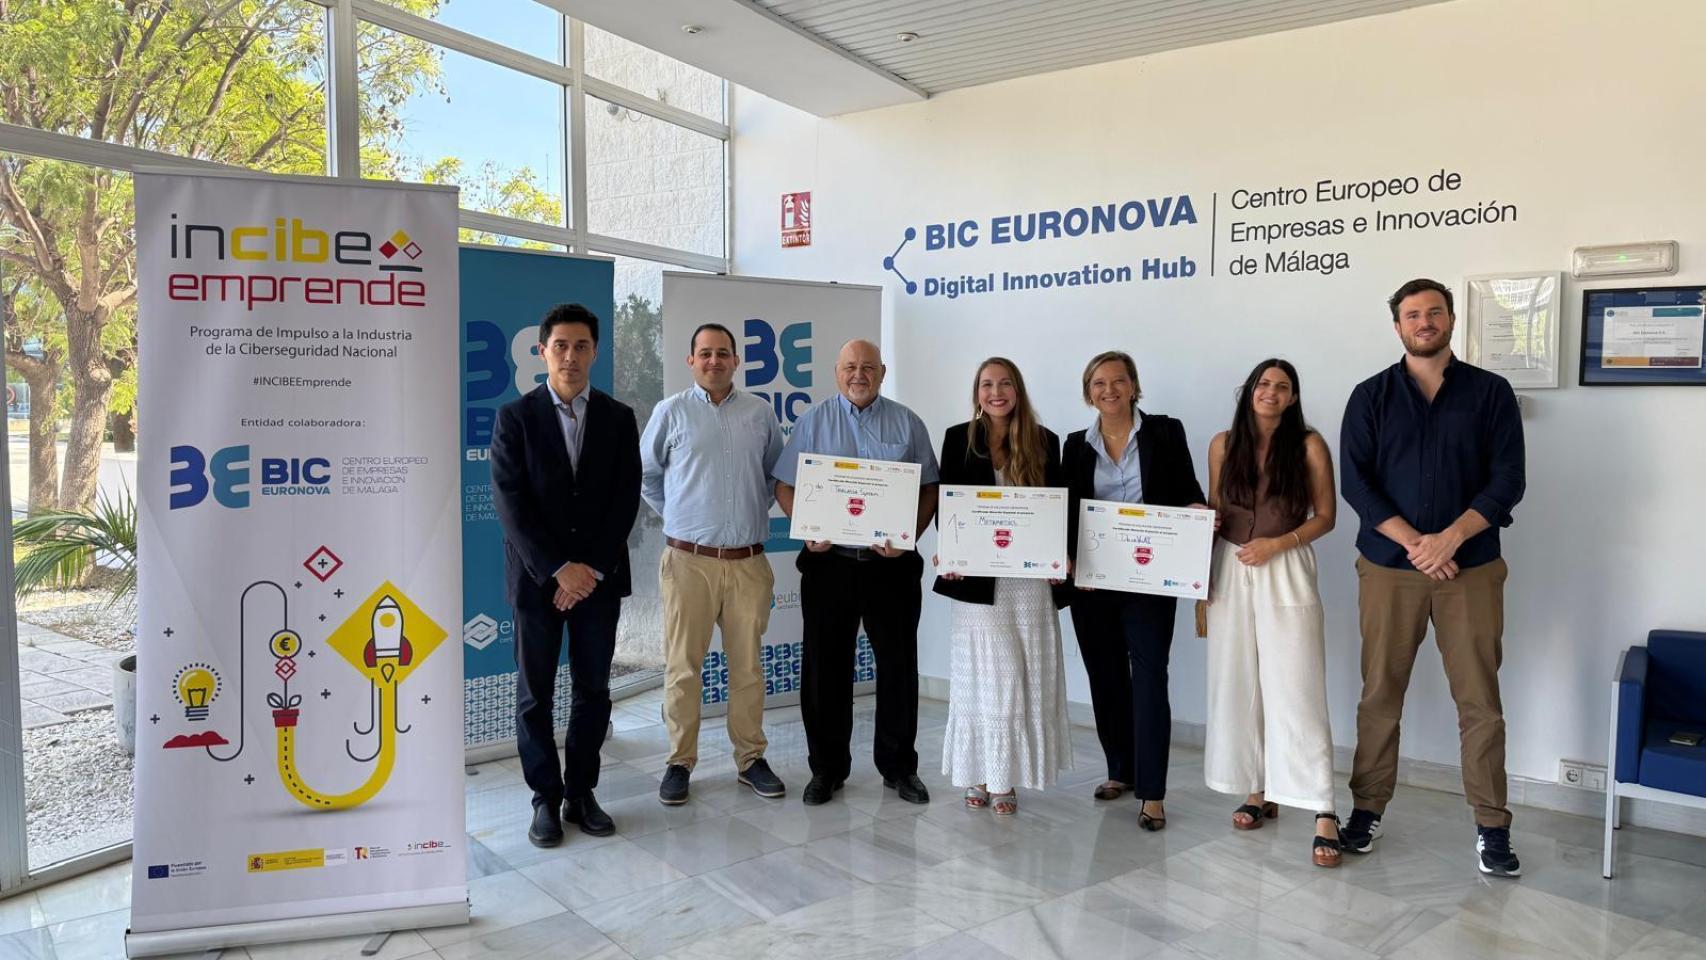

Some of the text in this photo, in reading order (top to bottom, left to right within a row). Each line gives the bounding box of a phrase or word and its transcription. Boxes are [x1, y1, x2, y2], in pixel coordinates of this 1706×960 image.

[1231, 168, 1462, 210] Centro Europeo de
[925, 194, 1198, 251] BIC EURONOVA
[1231, 200, 1517, 244] Empresas e Innovación
[171, 213, 371, 265] incibe
[1229, 249, 1350, 276] de Málaga
[923, 256, 1196, 299] Digital Innovation Hub
[168, 273, 426, 311] emprende
[190, 325, 412, 342] Programa de Impulso a la Industria
[206, 343, 397, 360] de la Ciberseguridad Nacional
[253, 376, 352, 388] #INCIBEEmprende
[240, 418, 366, 428] Entidad colaboradora:
[342, 456, 429, 465] CENTRO EUROPEO
[261, 457, 331, 485] BIC
[342, 466, 408, 475] DE EMPRESAS
[342, 476, 349, 485] E
[262, 486, 331, 496] EURONOVA
[342, 486, 355, 495] DE
